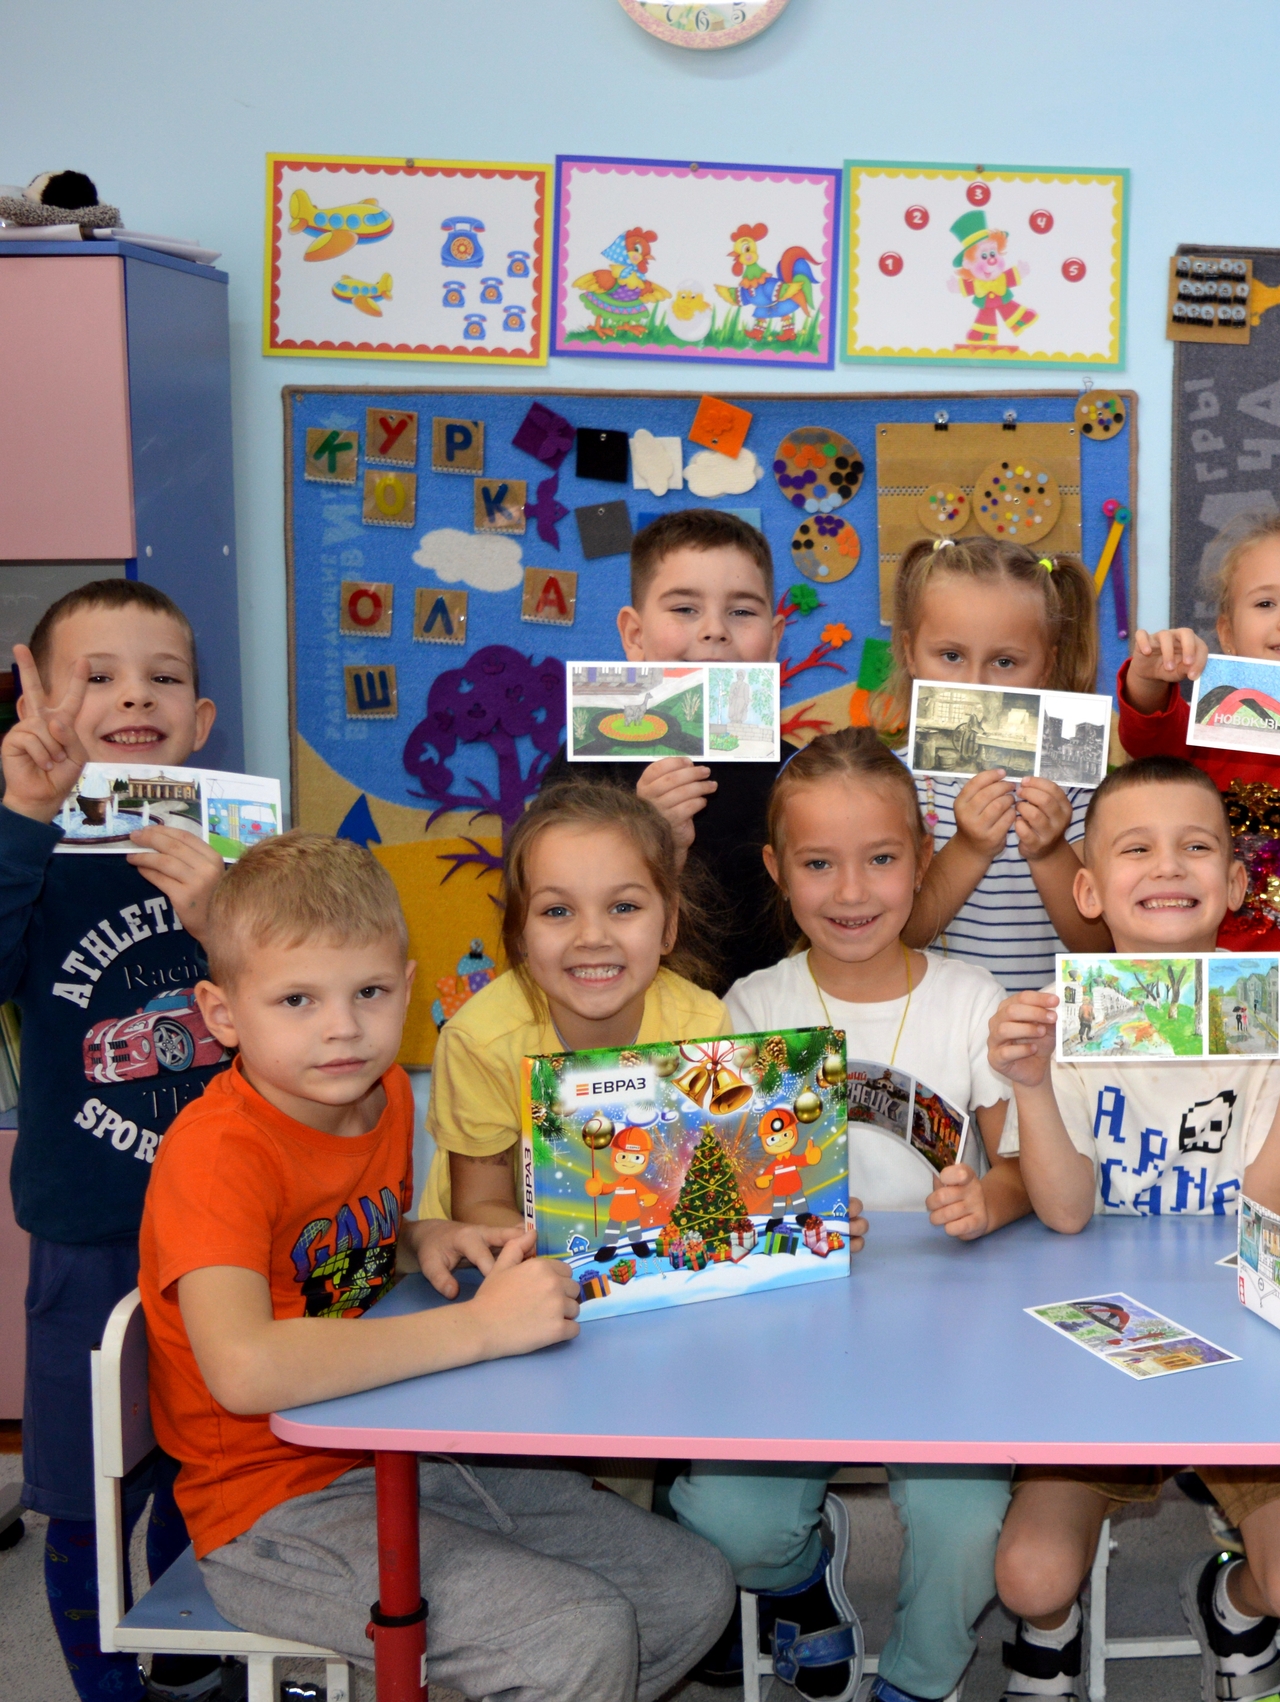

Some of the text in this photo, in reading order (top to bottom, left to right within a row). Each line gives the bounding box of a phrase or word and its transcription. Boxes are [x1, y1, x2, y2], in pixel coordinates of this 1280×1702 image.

[695, 9, 710, 32] 6
[731, 2, 747, 24] 5
[592, 1077, 646, 1095] ЕВРАЗ
[74, 1098, 164, 1164] SPOR
[525, 1147, 534, 1219] ЕВРАЗ
